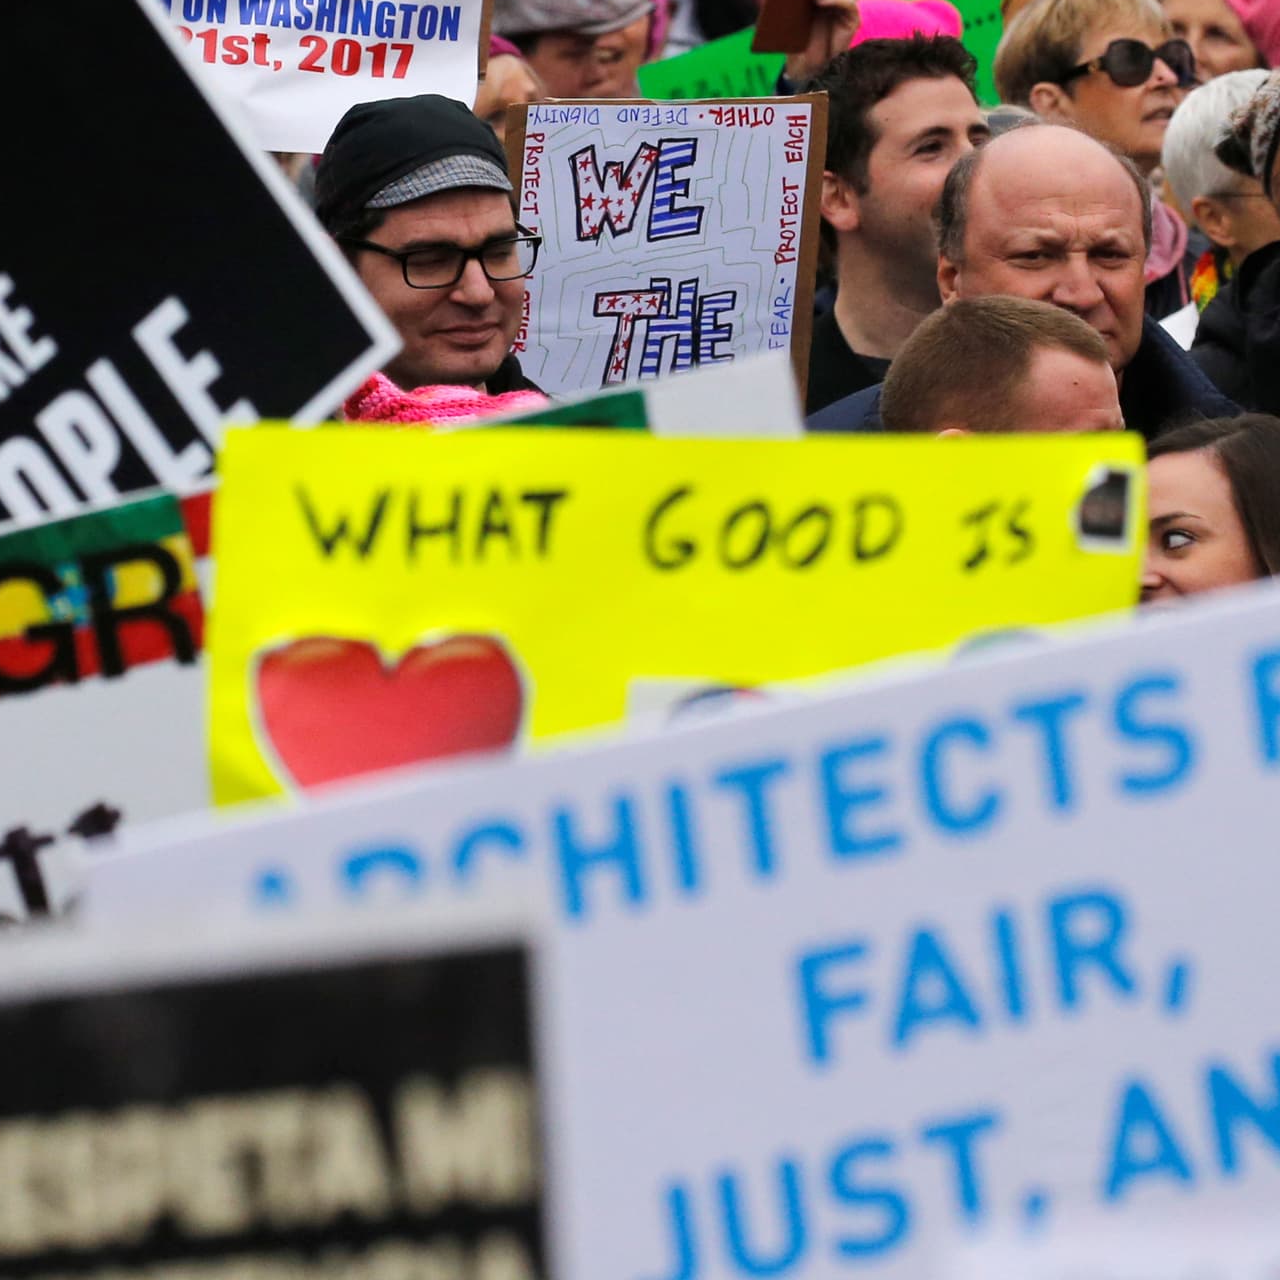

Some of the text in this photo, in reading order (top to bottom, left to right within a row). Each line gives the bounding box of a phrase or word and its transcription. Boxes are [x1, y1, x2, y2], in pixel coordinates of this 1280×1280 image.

[299, 34, 415, 81] 2017
[616, 106, 689, 126] DEFEND
[707, 105, 776, 128] OTHER
[523, 131, 546, 216] PROTECT
[568, 137, 706, 246] WE
[773, 114, 809, 266] PROTECT EACH
[592, 277, 738, 389] THE
[768, 285, 792, 351] FEAR
[293, 482, 1034, 575] WHAT GOOD IS
[248, 665, 1203, 925] HITECTS
[788, 880, 1198, 1072] FAIR,
[625, 1106, 1052, 1280] JUST,
